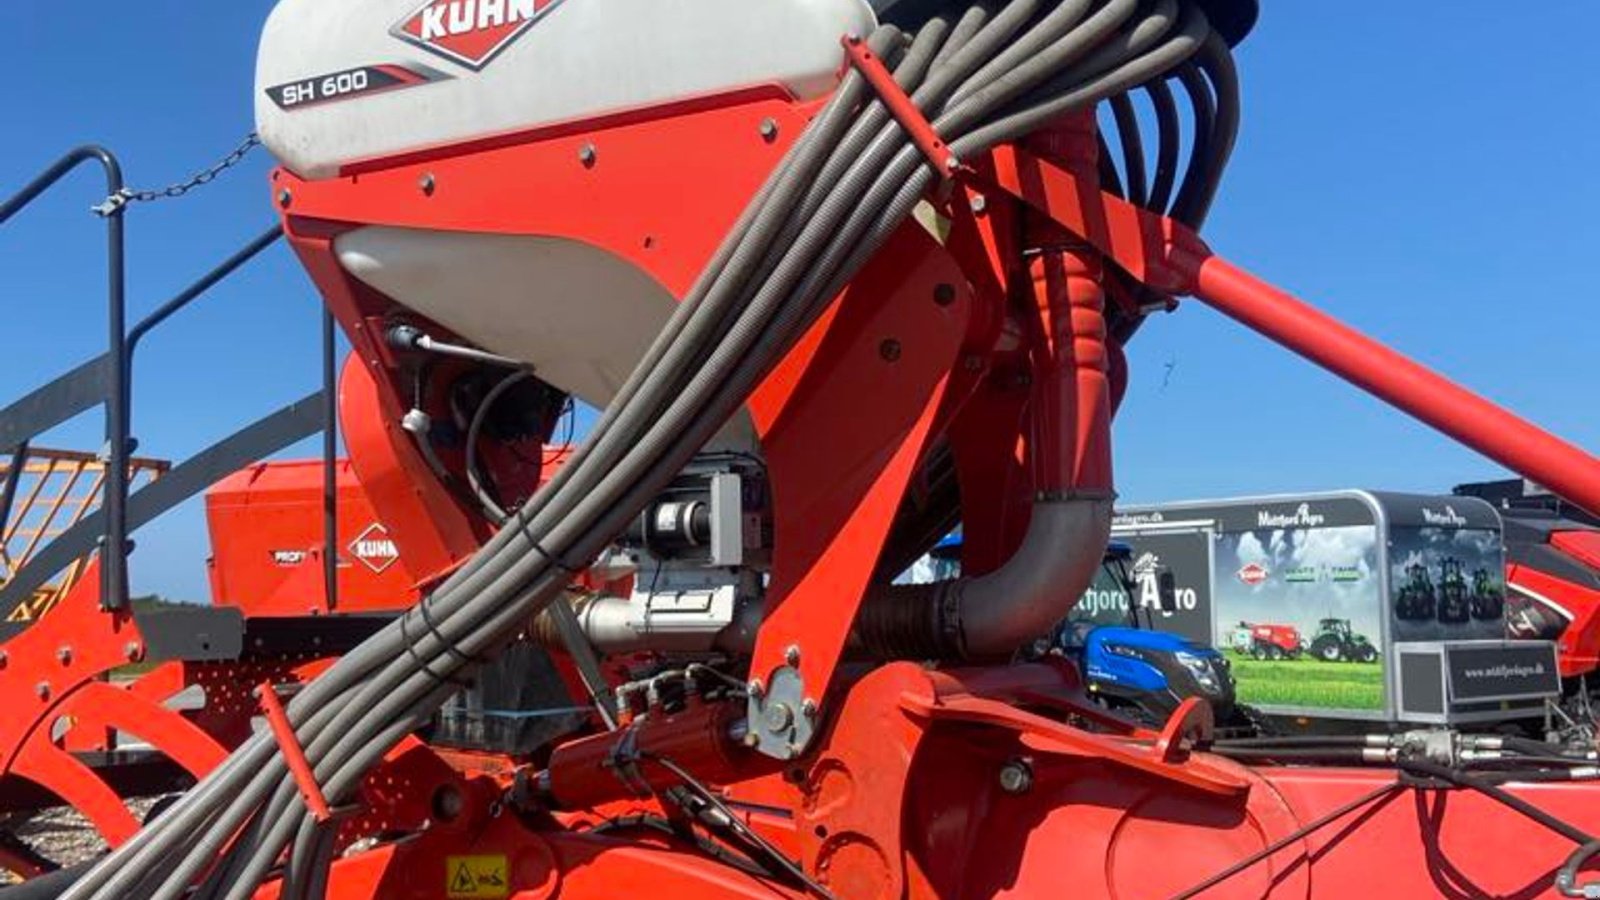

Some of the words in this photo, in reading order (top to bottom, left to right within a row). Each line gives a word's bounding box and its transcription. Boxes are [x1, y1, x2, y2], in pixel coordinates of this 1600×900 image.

[420, 0, 536, 42] KUHN
[282, 81, 314, 105] SH
[321, 70, 368, 97] 600
[1140, 574, 1197, 618] Aro
